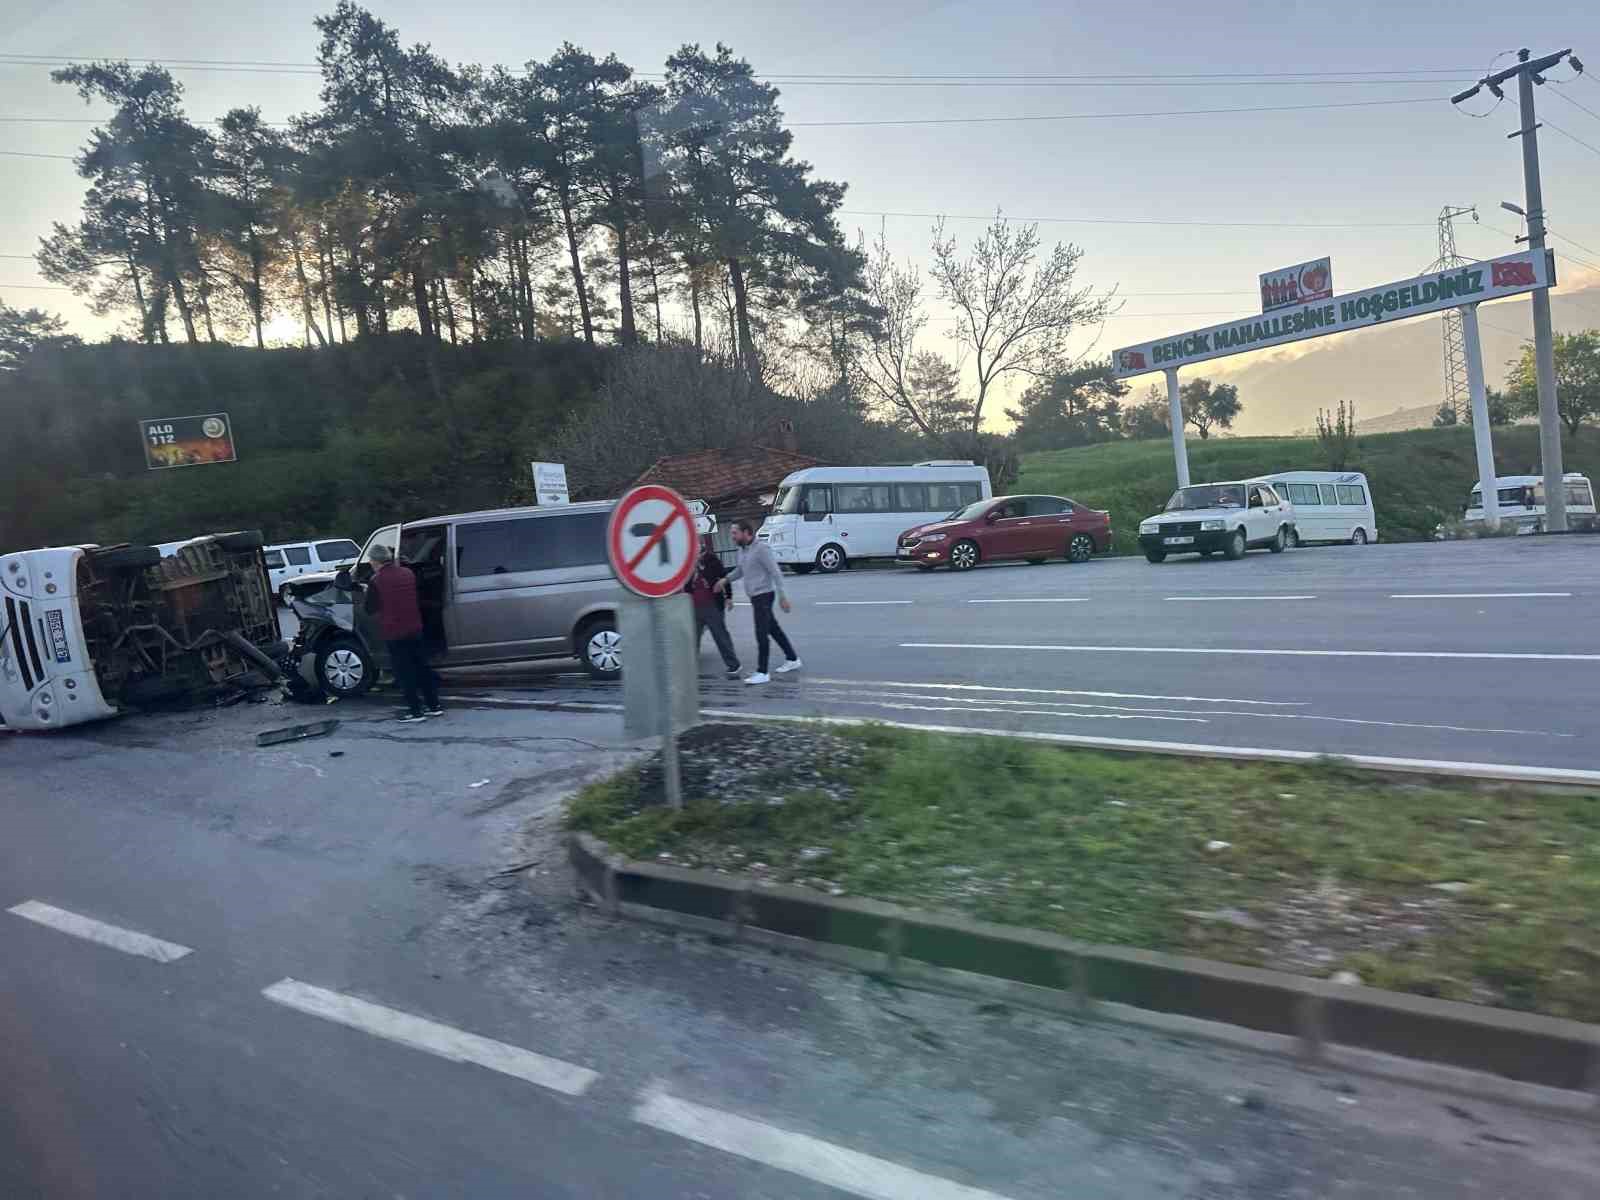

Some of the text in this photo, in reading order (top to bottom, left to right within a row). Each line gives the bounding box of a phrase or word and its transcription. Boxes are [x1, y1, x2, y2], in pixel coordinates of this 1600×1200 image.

[1152, 269, 1484, 363] BENCİK MAHALLESİNE HOŞGELDİNİZ
[151, 434, 176, 445] 112
